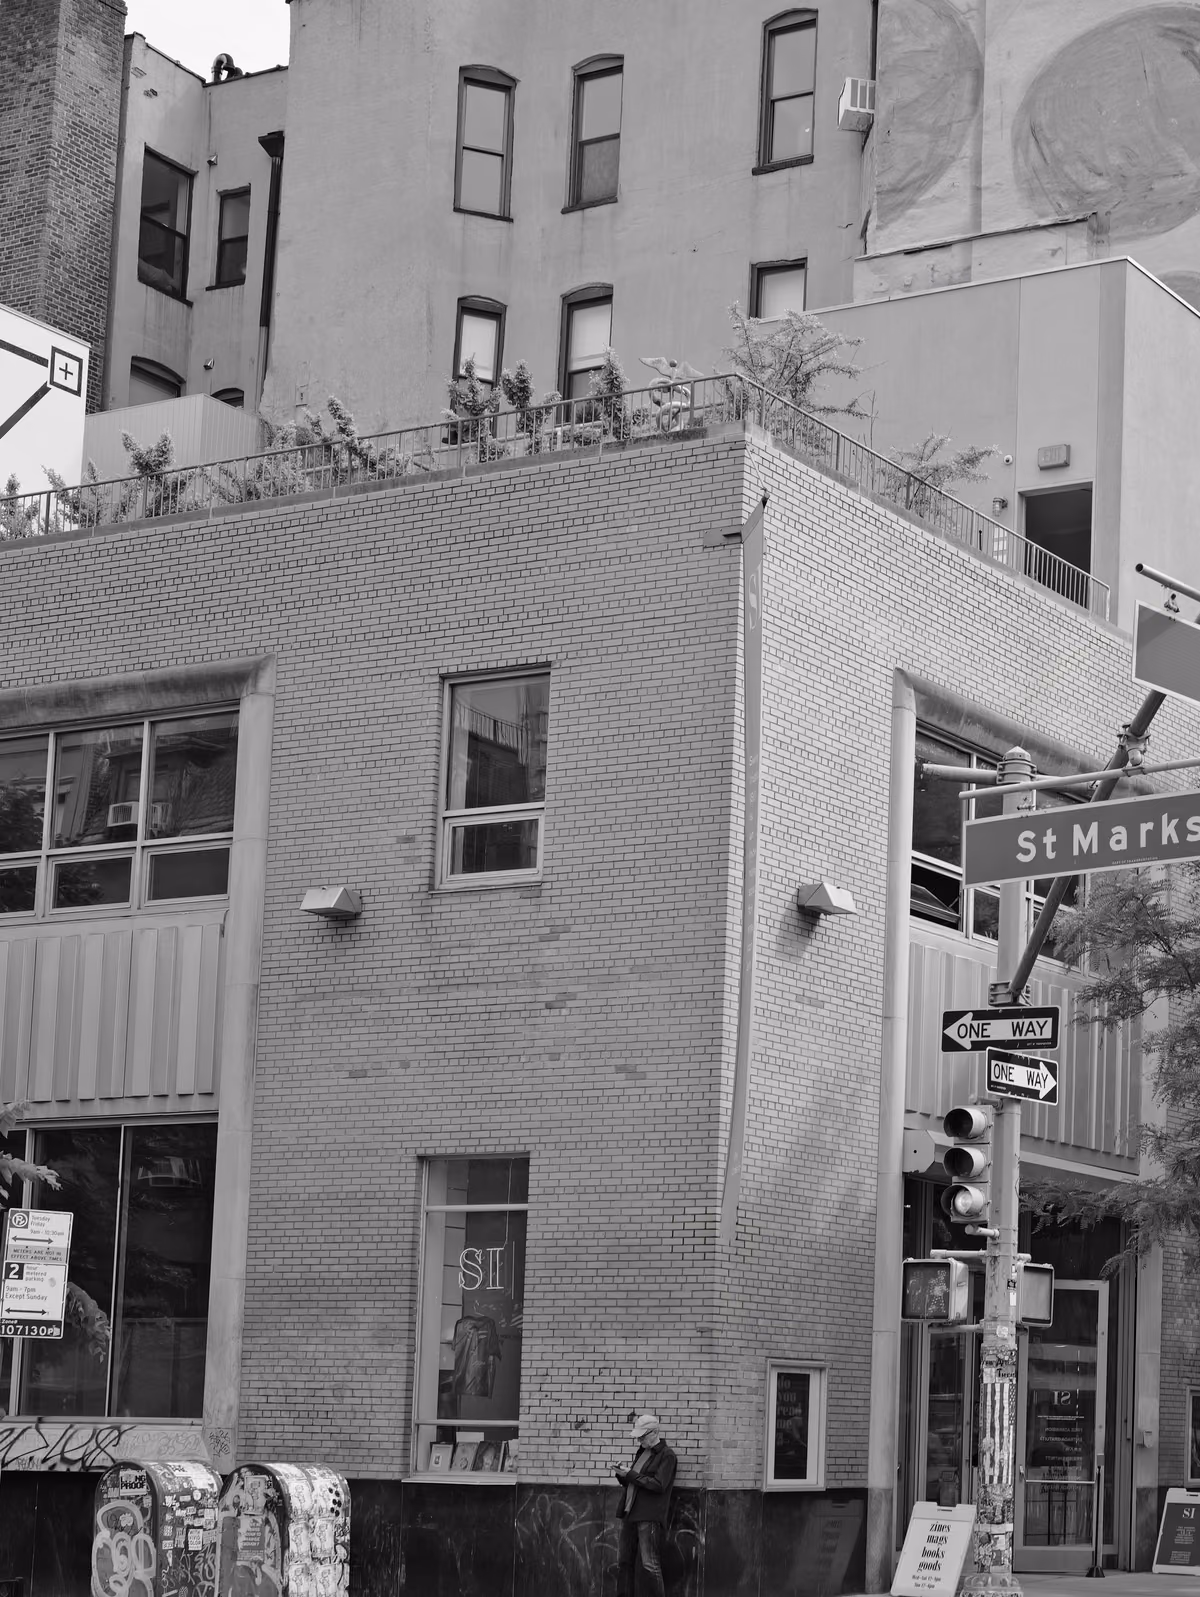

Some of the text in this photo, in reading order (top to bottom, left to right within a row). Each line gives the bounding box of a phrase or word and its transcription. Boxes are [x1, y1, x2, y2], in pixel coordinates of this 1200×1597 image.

[1016, 830, 1056, 864] St
[957, 1020, 1048, 1039] ONE WAY
[993, 1063, 1049, 1089] ONE WAY
[9, 1264, 19, 1279] 2
[458, 1248, 505, 1291] SI
[5, 1292, 25, 1300] Except
[1, 1324, 47, 1336] 107130
[121, 1475, 146, 1483] LNG
[121, 1481, 146, 1490] PROOF
[1182, 1507, 1196, 1519] SI
[929, 1521, 952, 1533] zines
[926, 1535, 949, 1546] mags
[921, 1546, 946, 1559] books
[916, 1560, 942, 1573] goods
